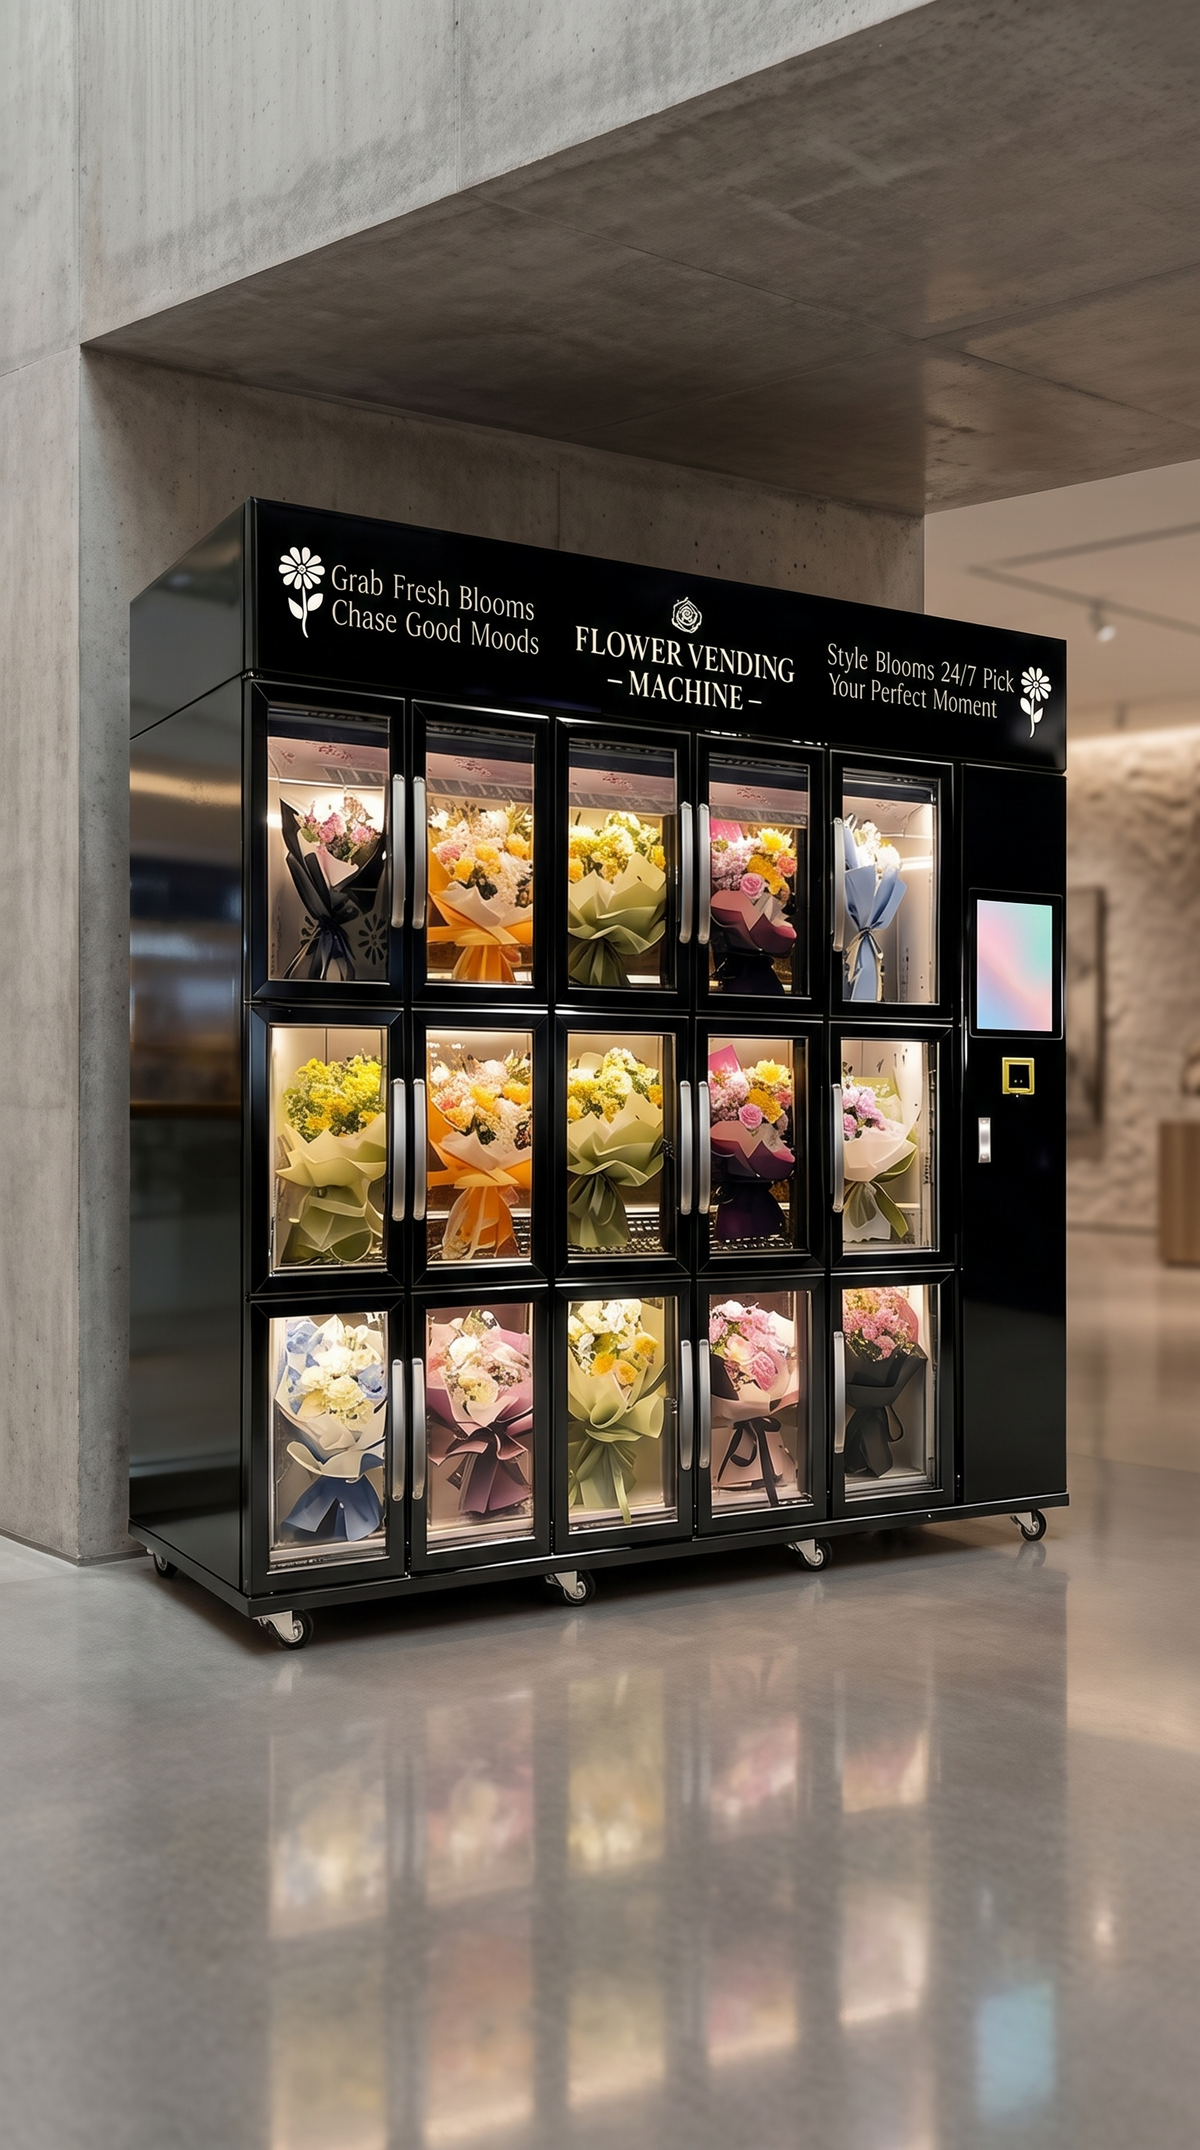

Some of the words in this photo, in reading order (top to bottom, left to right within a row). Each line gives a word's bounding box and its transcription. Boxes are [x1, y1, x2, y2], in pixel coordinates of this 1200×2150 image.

[331, 564, 384, 596] Grab
[393, 573, 450, 608] Fresh
[459, 585, 535, 621] Blooms
[331, 599, 397, 633] Chase
[405, 611, 461, 644] Good
[471, 620, 539, 655] Moods
[575, 625, 684, 667] FLOWER
[687, 642, 795, 684] VENDING
[827, 642, 869, 674] Style
[876, 650, 935, 681] Blooms
[940, 661, 977, 687] 24/7
[983, 667, 1015, 693] Pick
[828, 672, 866, 700] Your
[871, 679, 927, 709] Perfect
[933, 688, 998, 719] Moment
